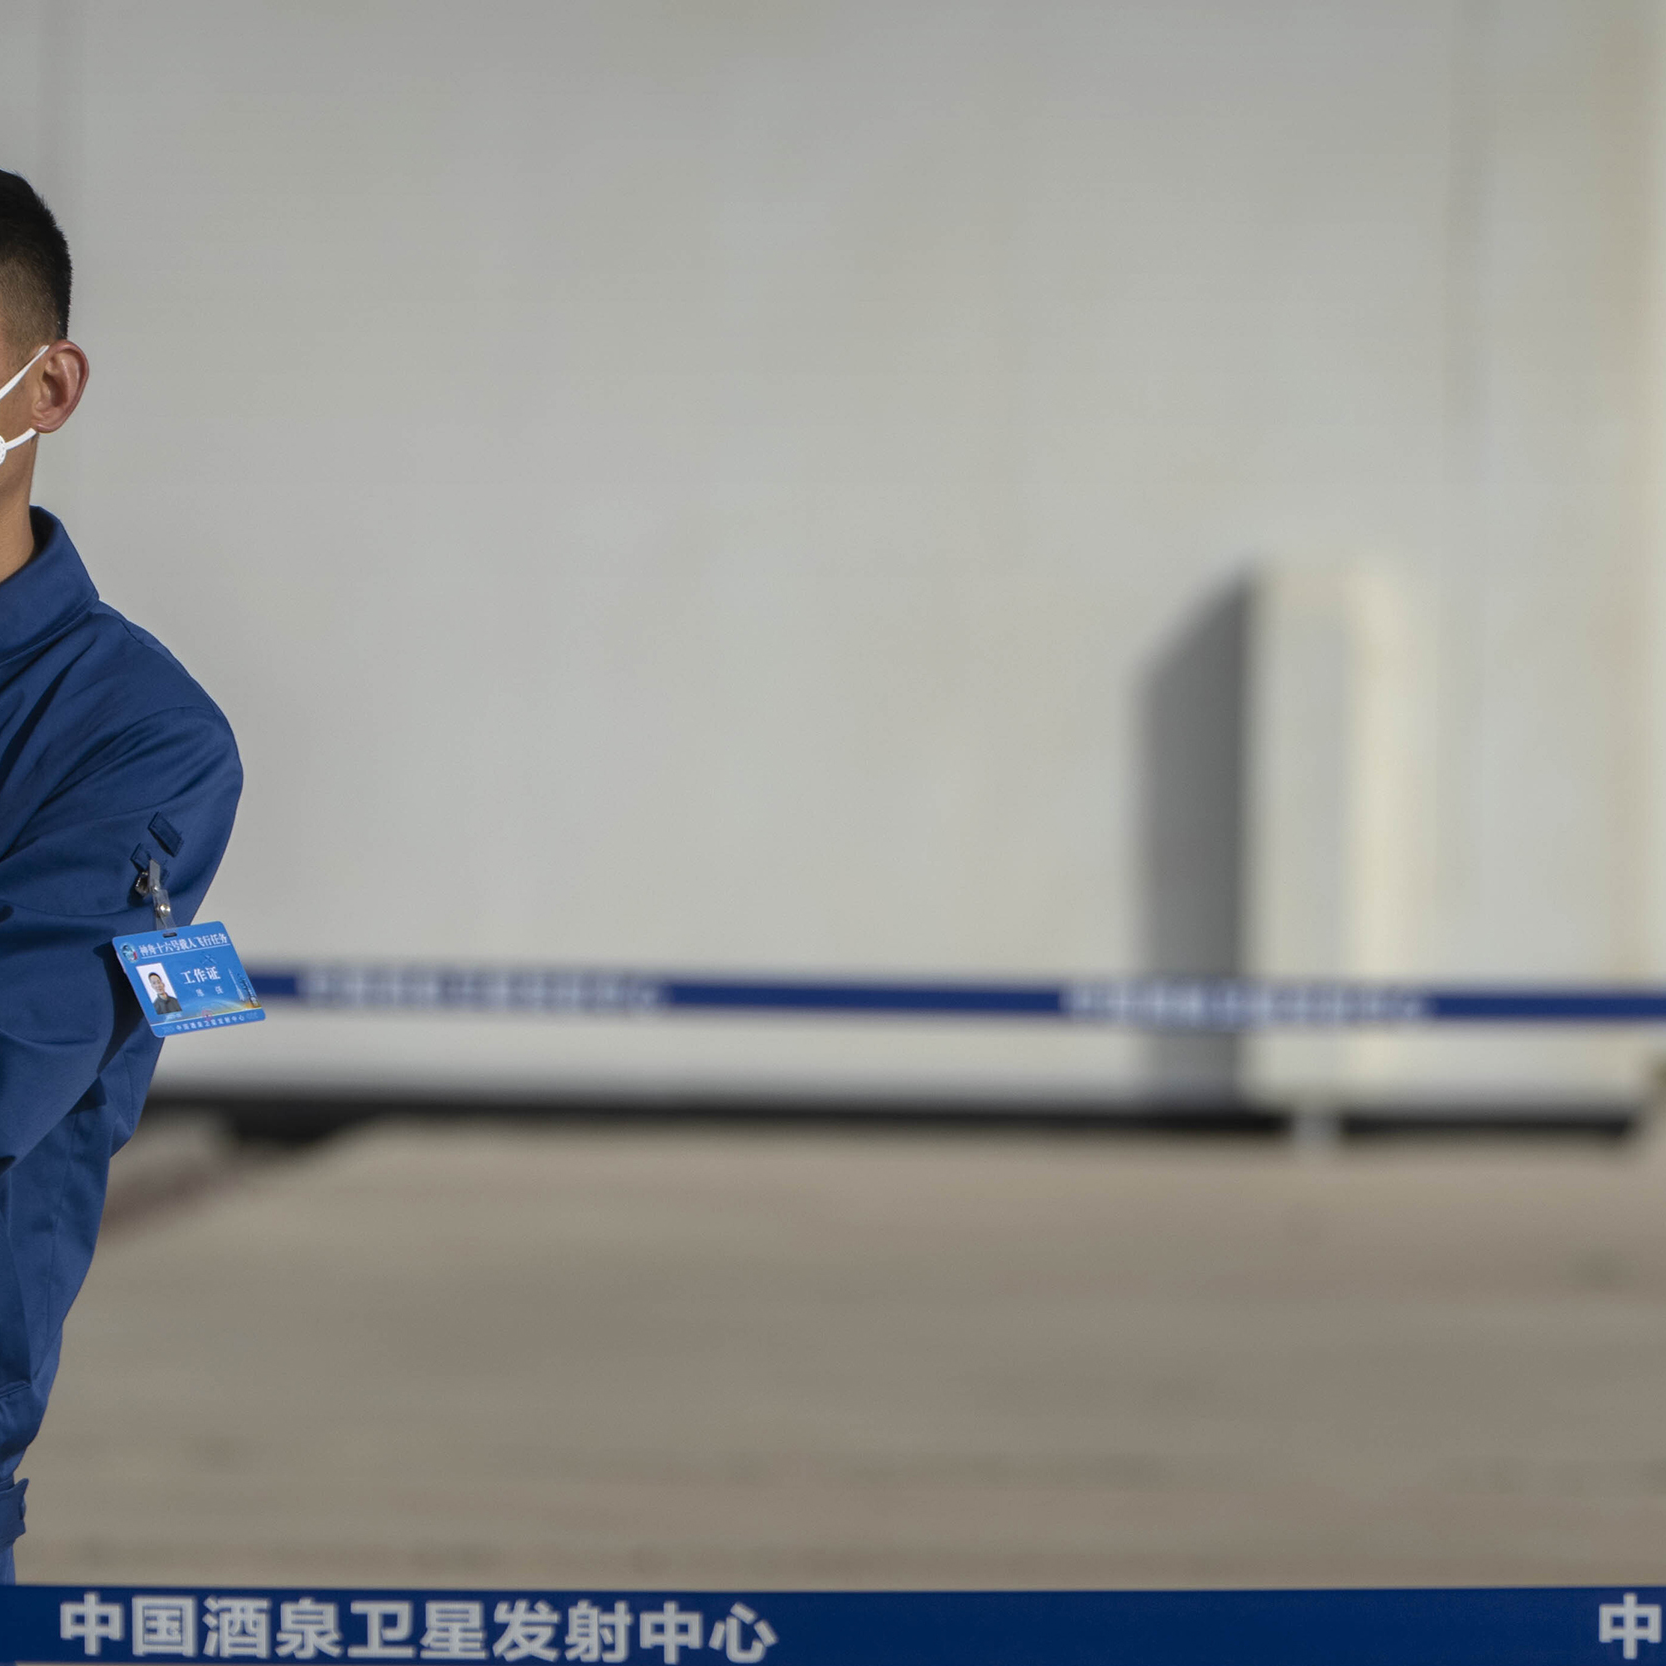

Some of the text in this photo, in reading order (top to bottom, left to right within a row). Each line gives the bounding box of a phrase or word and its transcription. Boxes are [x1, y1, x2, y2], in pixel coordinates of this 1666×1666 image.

[180, 966, 221, 985] 工作证
[59, 1592, 778, 1666] 中国酒泉卫星发射中心
